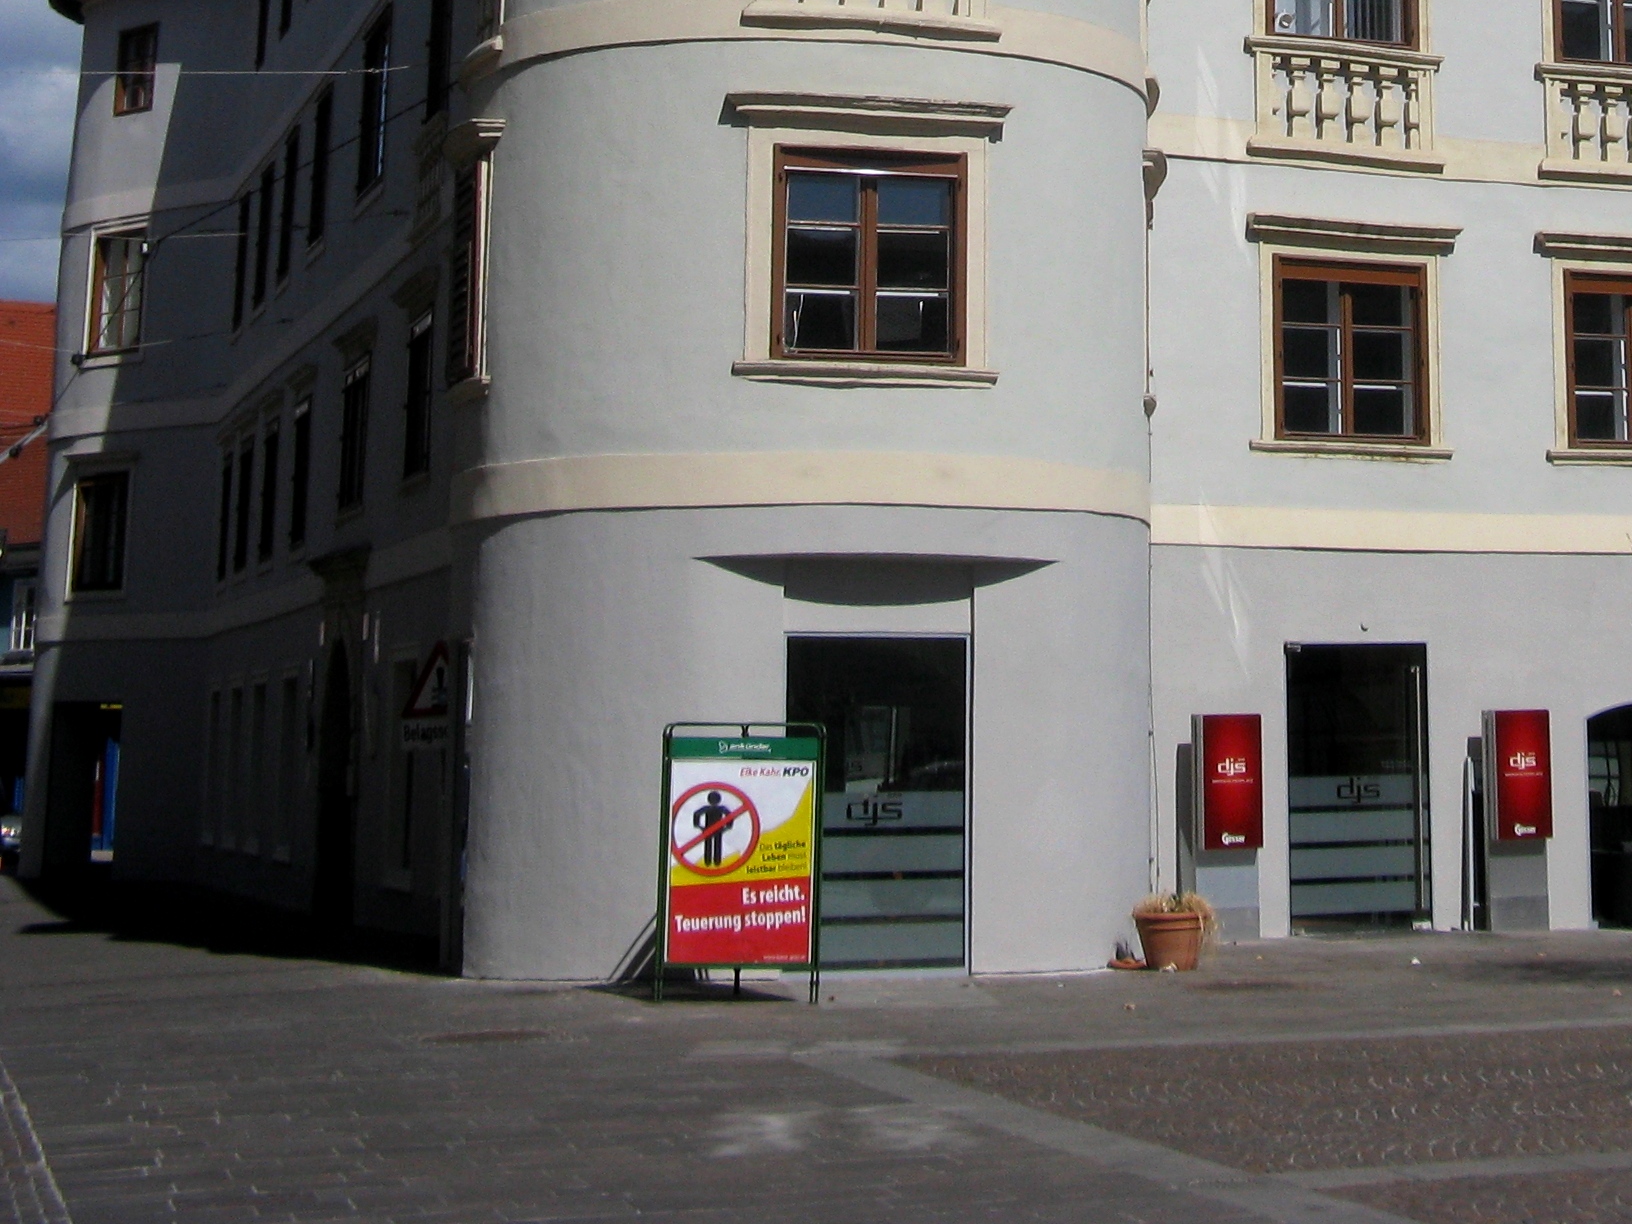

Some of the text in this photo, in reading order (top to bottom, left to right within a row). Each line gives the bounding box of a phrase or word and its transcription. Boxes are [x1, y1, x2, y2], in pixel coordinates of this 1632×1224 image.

[783, 765, 809, 777] KPÖ
[1217, 757, 1246, 776] djs
[1509, 752, 1537, 770] djs
[1337, 777, 1380, 804] djs
[846, 794, 903, 827] djs
[742, 884, 805, 905] Es reicht.
[674, 905, 806, 933] Teuerung stoppen!
